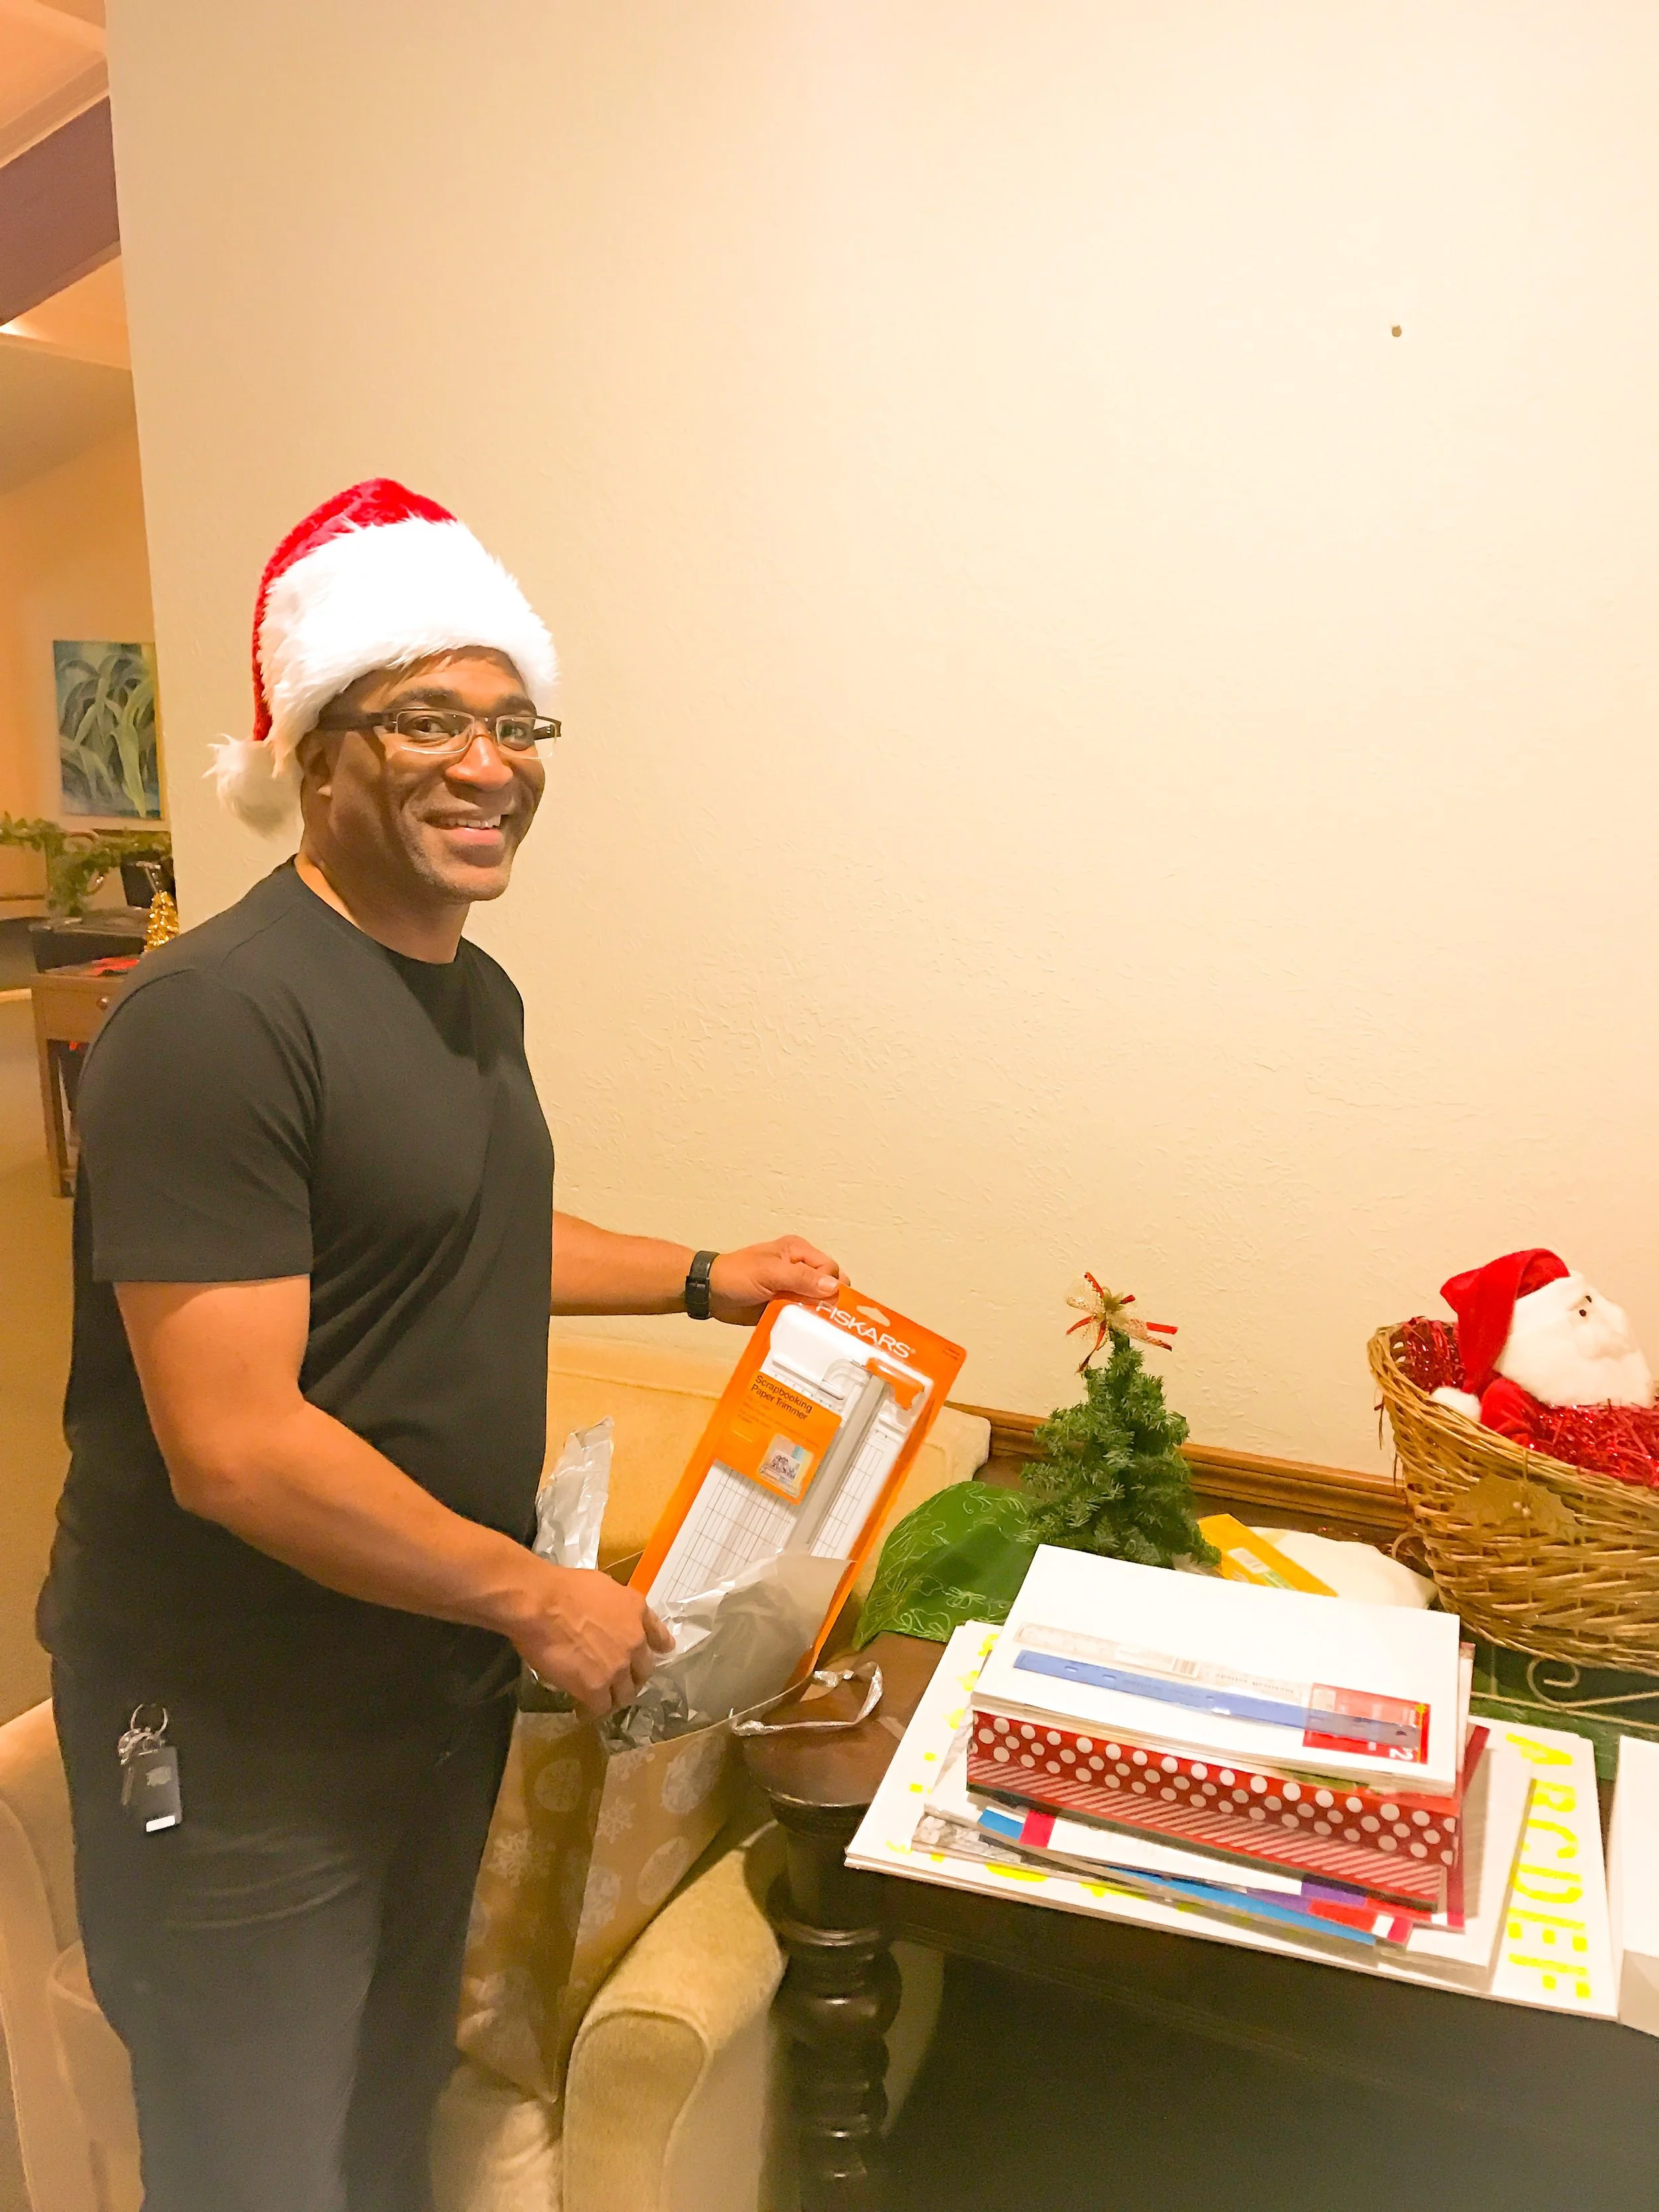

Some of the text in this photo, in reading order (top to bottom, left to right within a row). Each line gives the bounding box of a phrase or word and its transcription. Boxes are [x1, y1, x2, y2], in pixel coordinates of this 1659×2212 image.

[751, 1383, 775, 1402] Paper
[776, 1397, 808, 1420] Trimmer
[755, 1375, 813, 1414] Scrapbooking
